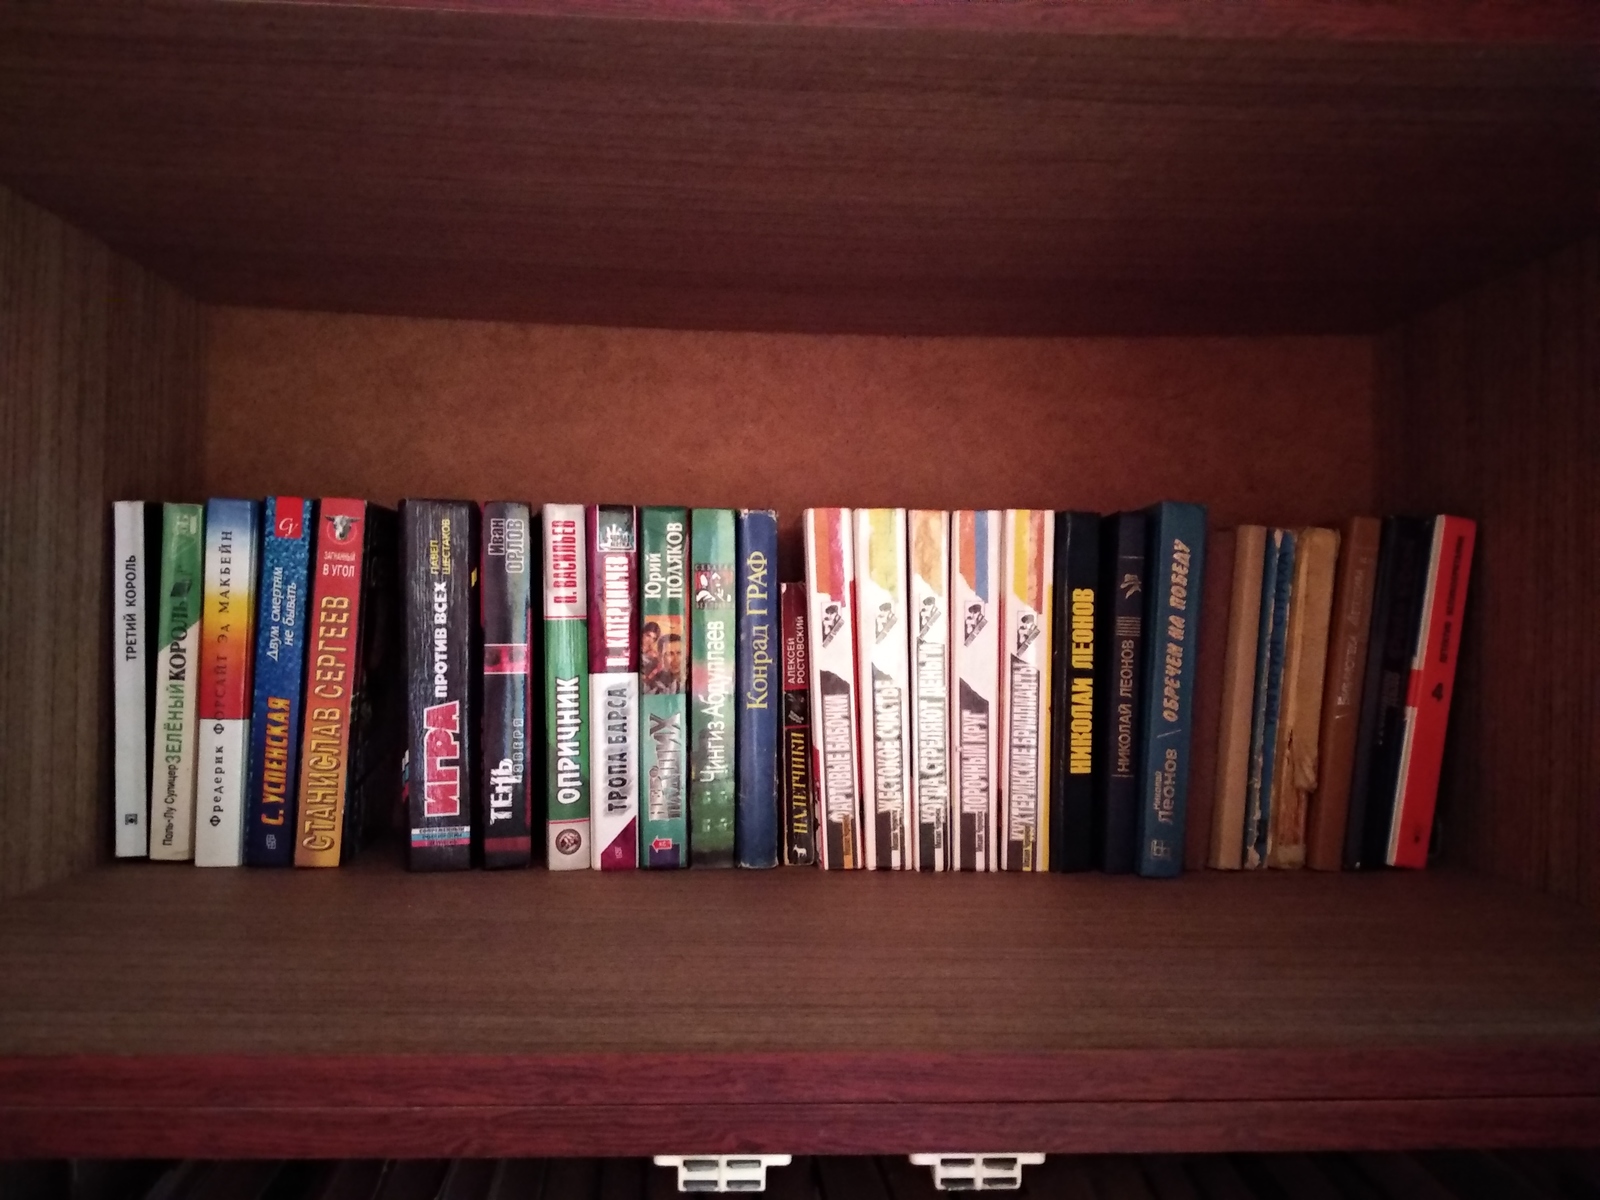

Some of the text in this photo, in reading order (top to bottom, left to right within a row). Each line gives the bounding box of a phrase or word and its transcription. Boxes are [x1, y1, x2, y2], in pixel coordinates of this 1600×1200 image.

[322, 563, 355, 578] В УГОЛ
[429, 539, 439, 575] ПАВЕЛ
[441, 518, 451, 575] ШЕСТАКОВ
[487, 518, 505, 556] Иван
[505, 518, 525, 573] ОРЛОВ
[551, 520, 578, 604] П. ВАСИЛЬЕВ
[643, 553, 664, 599] Юрий
[666, 522, 683, 599] ПОЛЯКОВ
[123, 555, 138, 661] ТРЕТИЙ КОРОЛЬ
[266, 566, 284, 662] Двум смертям
[283, 582, 297, 646] не бывать
[434, 581, 448, 698] ПРОТИВ ВСЕХ
[605, 555, 629, 648] КАТЕРИНИЧЕВ
[746, 551, 773, 710] Конрад ГРАФ
[1071, 588, 1095, 669] ЛЕОНОВ
[1162, 538, 1191, 722] ОБРЕЧЕН НА ПОБЕДУ
[165, 601, 188, 764] ЗЕЛЁНЫЙ КОРОЛЬ
[209, 530, 233, 827] Фредерик ФОРСАЙТ Эд МАКБЕЙН
[787, 638, 796, 684] АЛЕКСЕЙ
[795, 615, 806, 684] РОСТОВСКИЙ
[918, 642, 947, 698] ДЕНЬГИ
[302, 596, 350, 851] СТАНИСЛАВ СЕРГЕЕВ
[556, 676, 582, 805] ОПРИЧНИК
[698, 620, 732, 783] Чингиз Абдуллаев
[824, 694, 850, 752] БАБОЧКИ
[919, 699, 945, 775] СТРЕЛЯЮТ
[1011, 661, 1039, 746] БРИЛЛИАНТЫ
[1117, 639, 1135, 772] НИКОЛАЙ ЛЕОНОВ
[260, 696, 291, 826] С. УСПЕНСКАЯ
[423, 700, 460, 817] ИГРА
[607, 688, 627, 812] ТРОПА БАРСА
[790, 731, 808, 835] НАЛЕТЧИКИ
[875, 679, 902, 815] ЖЕСТОКОЕ СЧАСТЬЕ
[956, 709, 988, 813] ПОРОЧНЫЙ КРУГ
[1158, 748, 1178, 825] Леонов
[162, 764, 179, 846] Поль-Лу Сулицер
